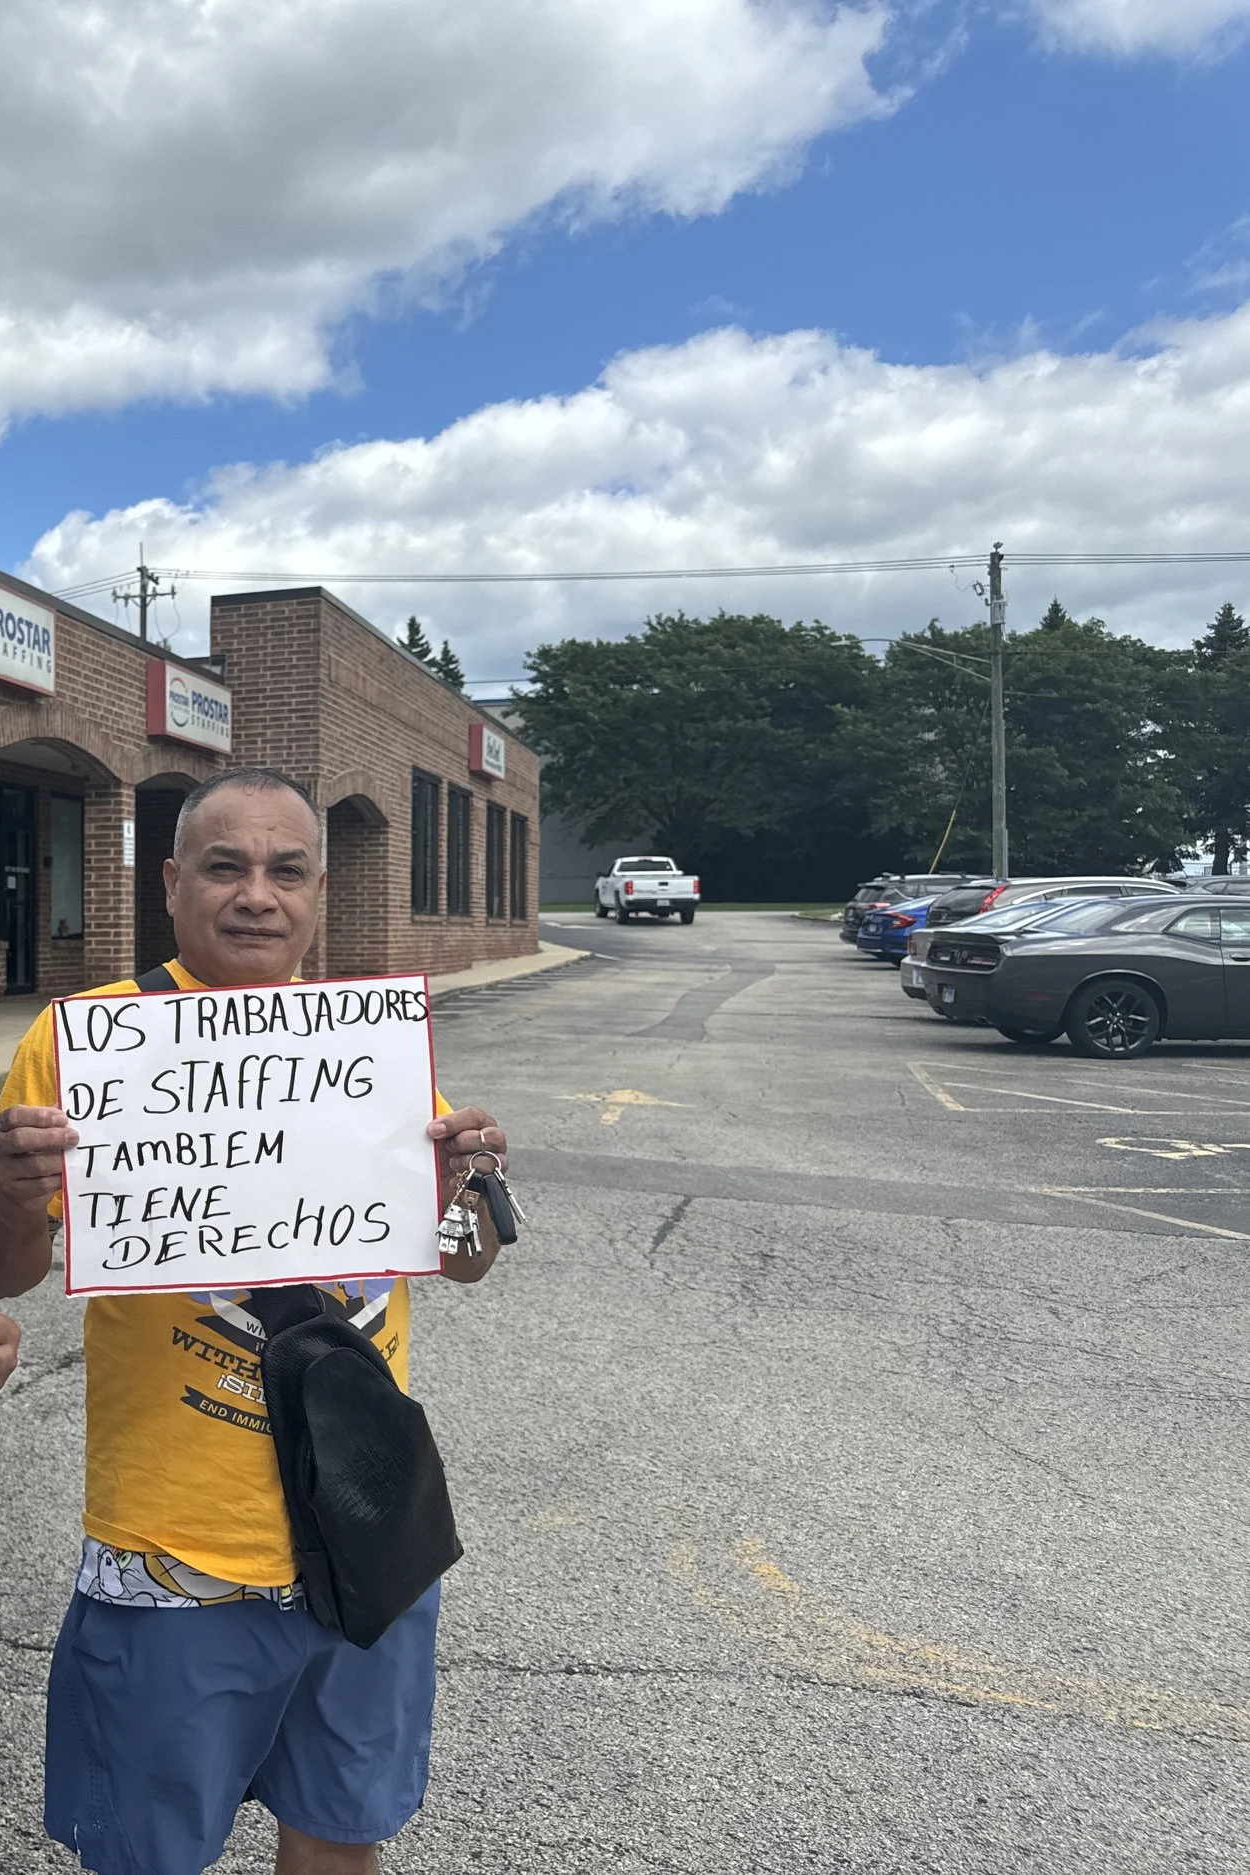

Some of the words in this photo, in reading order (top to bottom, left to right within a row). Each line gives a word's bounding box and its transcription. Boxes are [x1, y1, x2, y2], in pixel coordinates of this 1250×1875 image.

[191, 690, 229, 725] PROSTAR
[56, 1000, 147, 1053] LOS
[163, 988, 429, 1045] TRABAJADORES
[66, 1079, 125, 1121] DE
[78, 1185, 232, 1229] TIENE
[102, 1197, 391, 1270] DERECHOS
[171, 1326, 262, 1382] WITH
[199, 1399, 229, 1418] END
